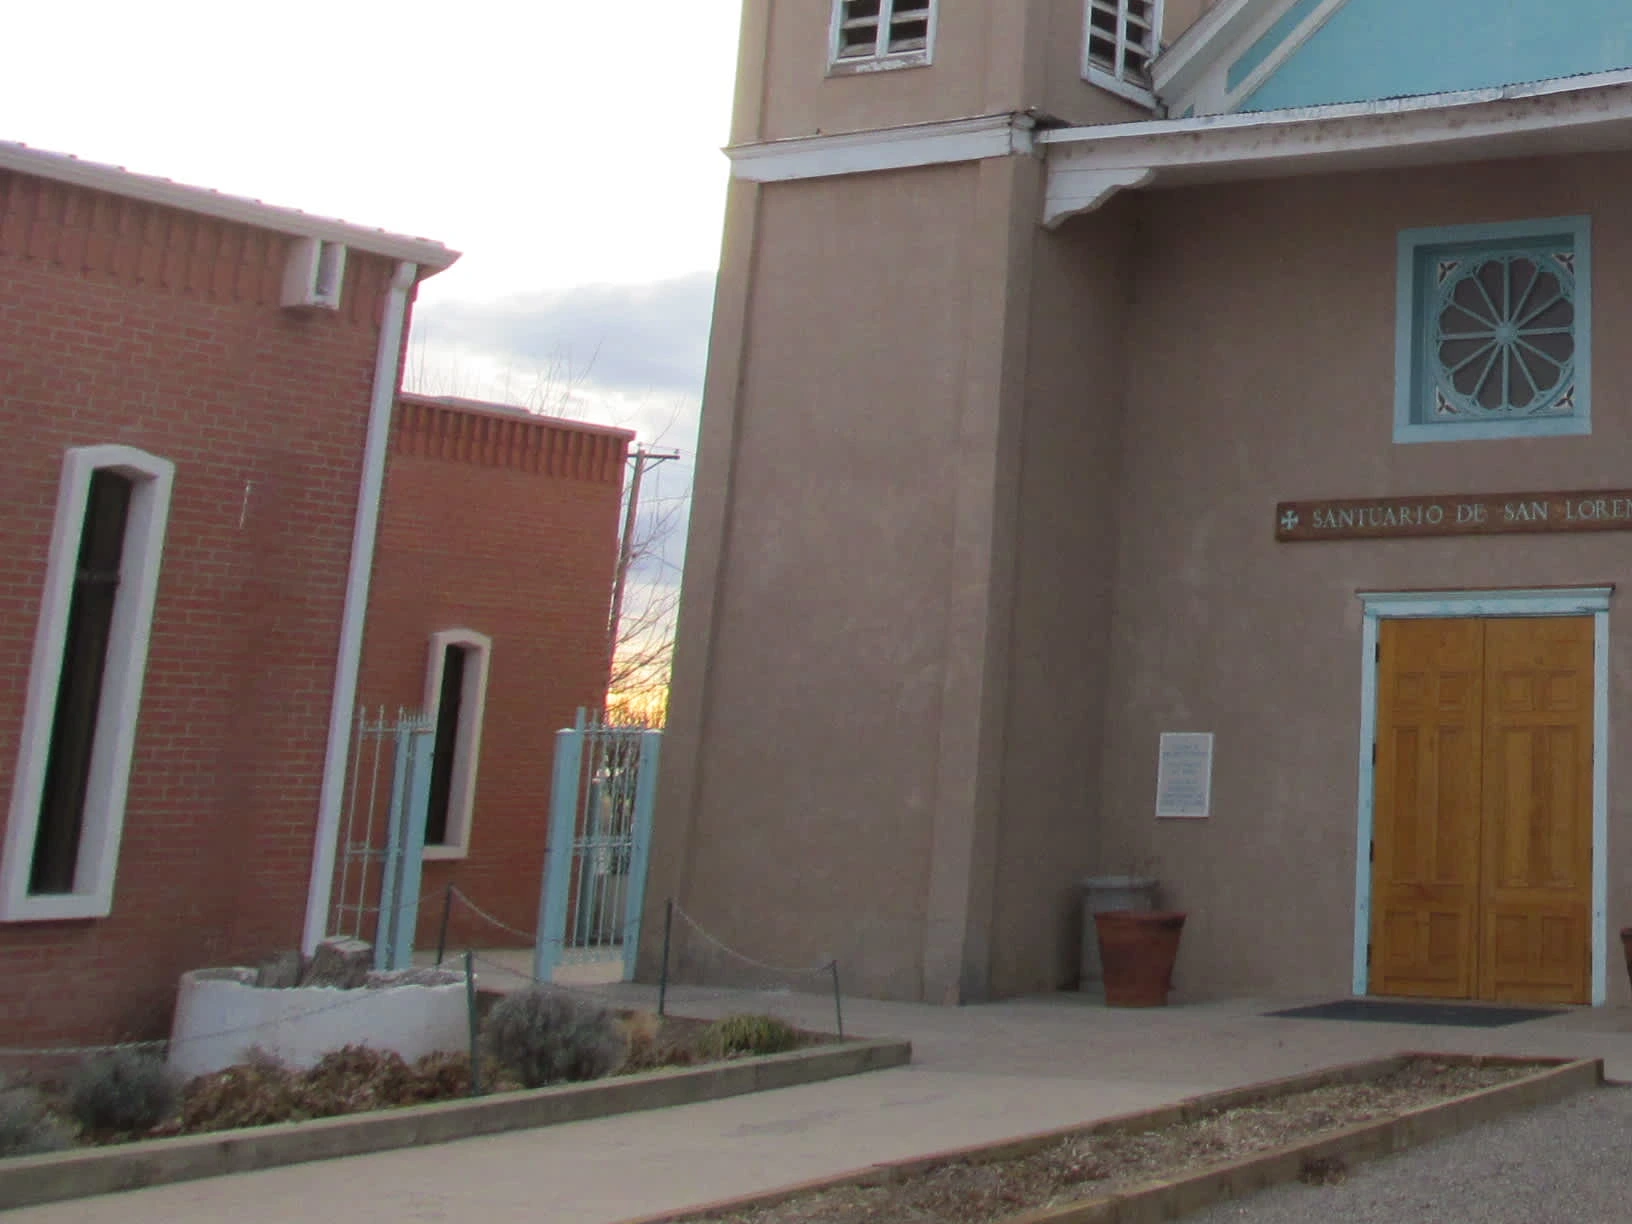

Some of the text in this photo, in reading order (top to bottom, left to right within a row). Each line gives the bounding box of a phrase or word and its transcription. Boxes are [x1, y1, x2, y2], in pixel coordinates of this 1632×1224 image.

[1312, 505, 1442, 528] SANTUARIO
[1456, 503, 1484, 522] DE
[1504, 502, 1549, 521] SAN
